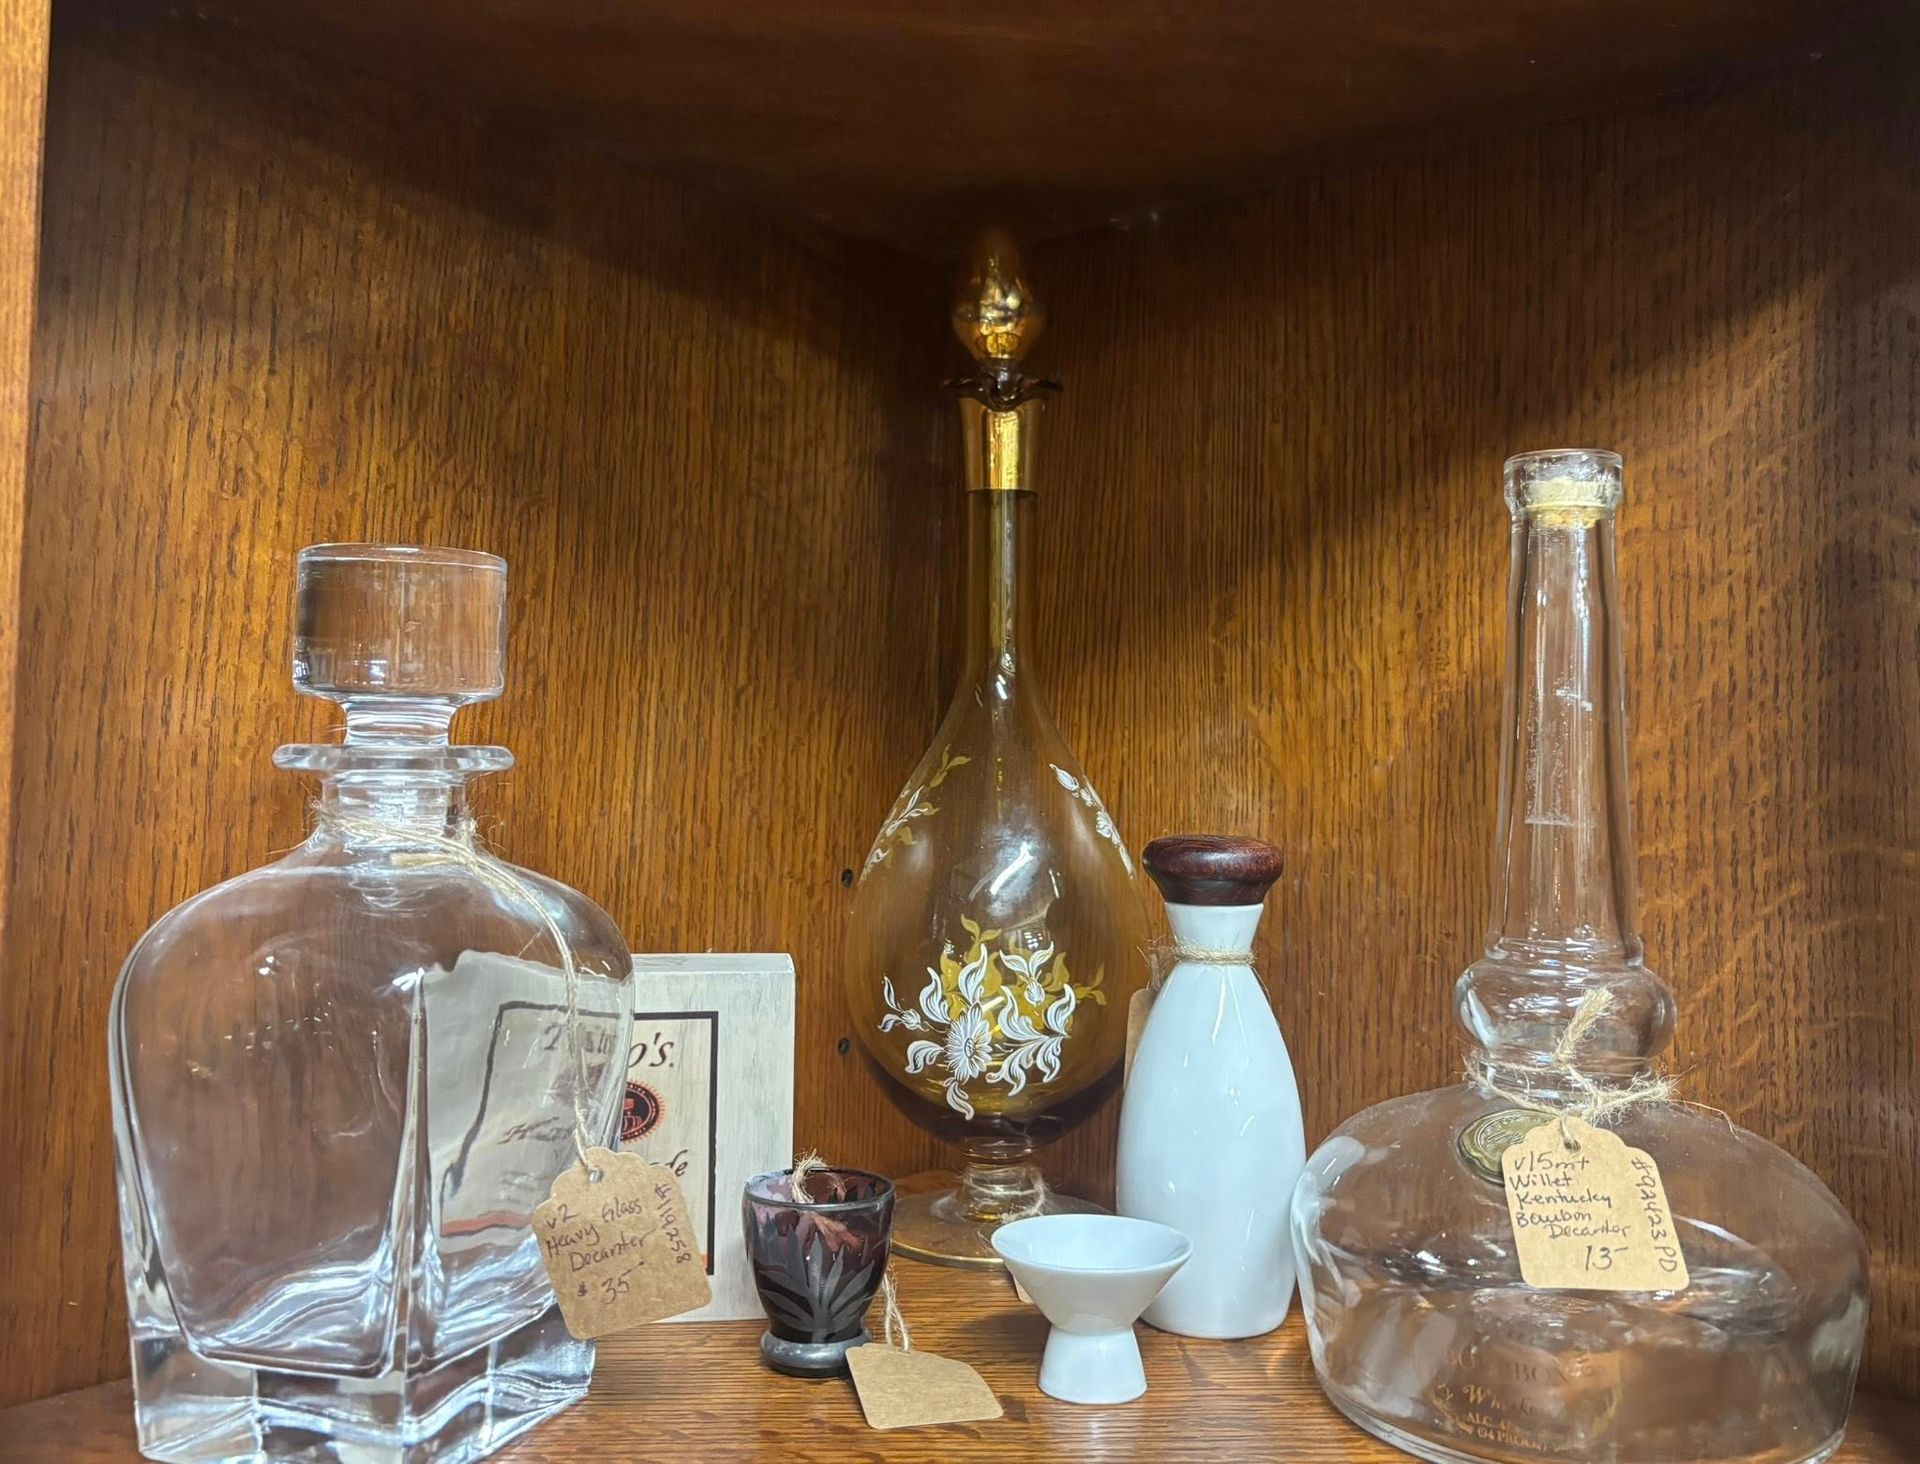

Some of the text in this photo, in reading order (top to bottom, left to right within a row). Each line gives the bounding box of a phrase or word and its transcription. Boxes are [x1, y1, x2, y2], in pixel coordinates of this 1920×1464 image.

[1516, 1188, 1612, 1210] Kentucky
[545, 1198, 642, 1258] Heavy Glass
[569, 1229, 657, 1272] Decanter
